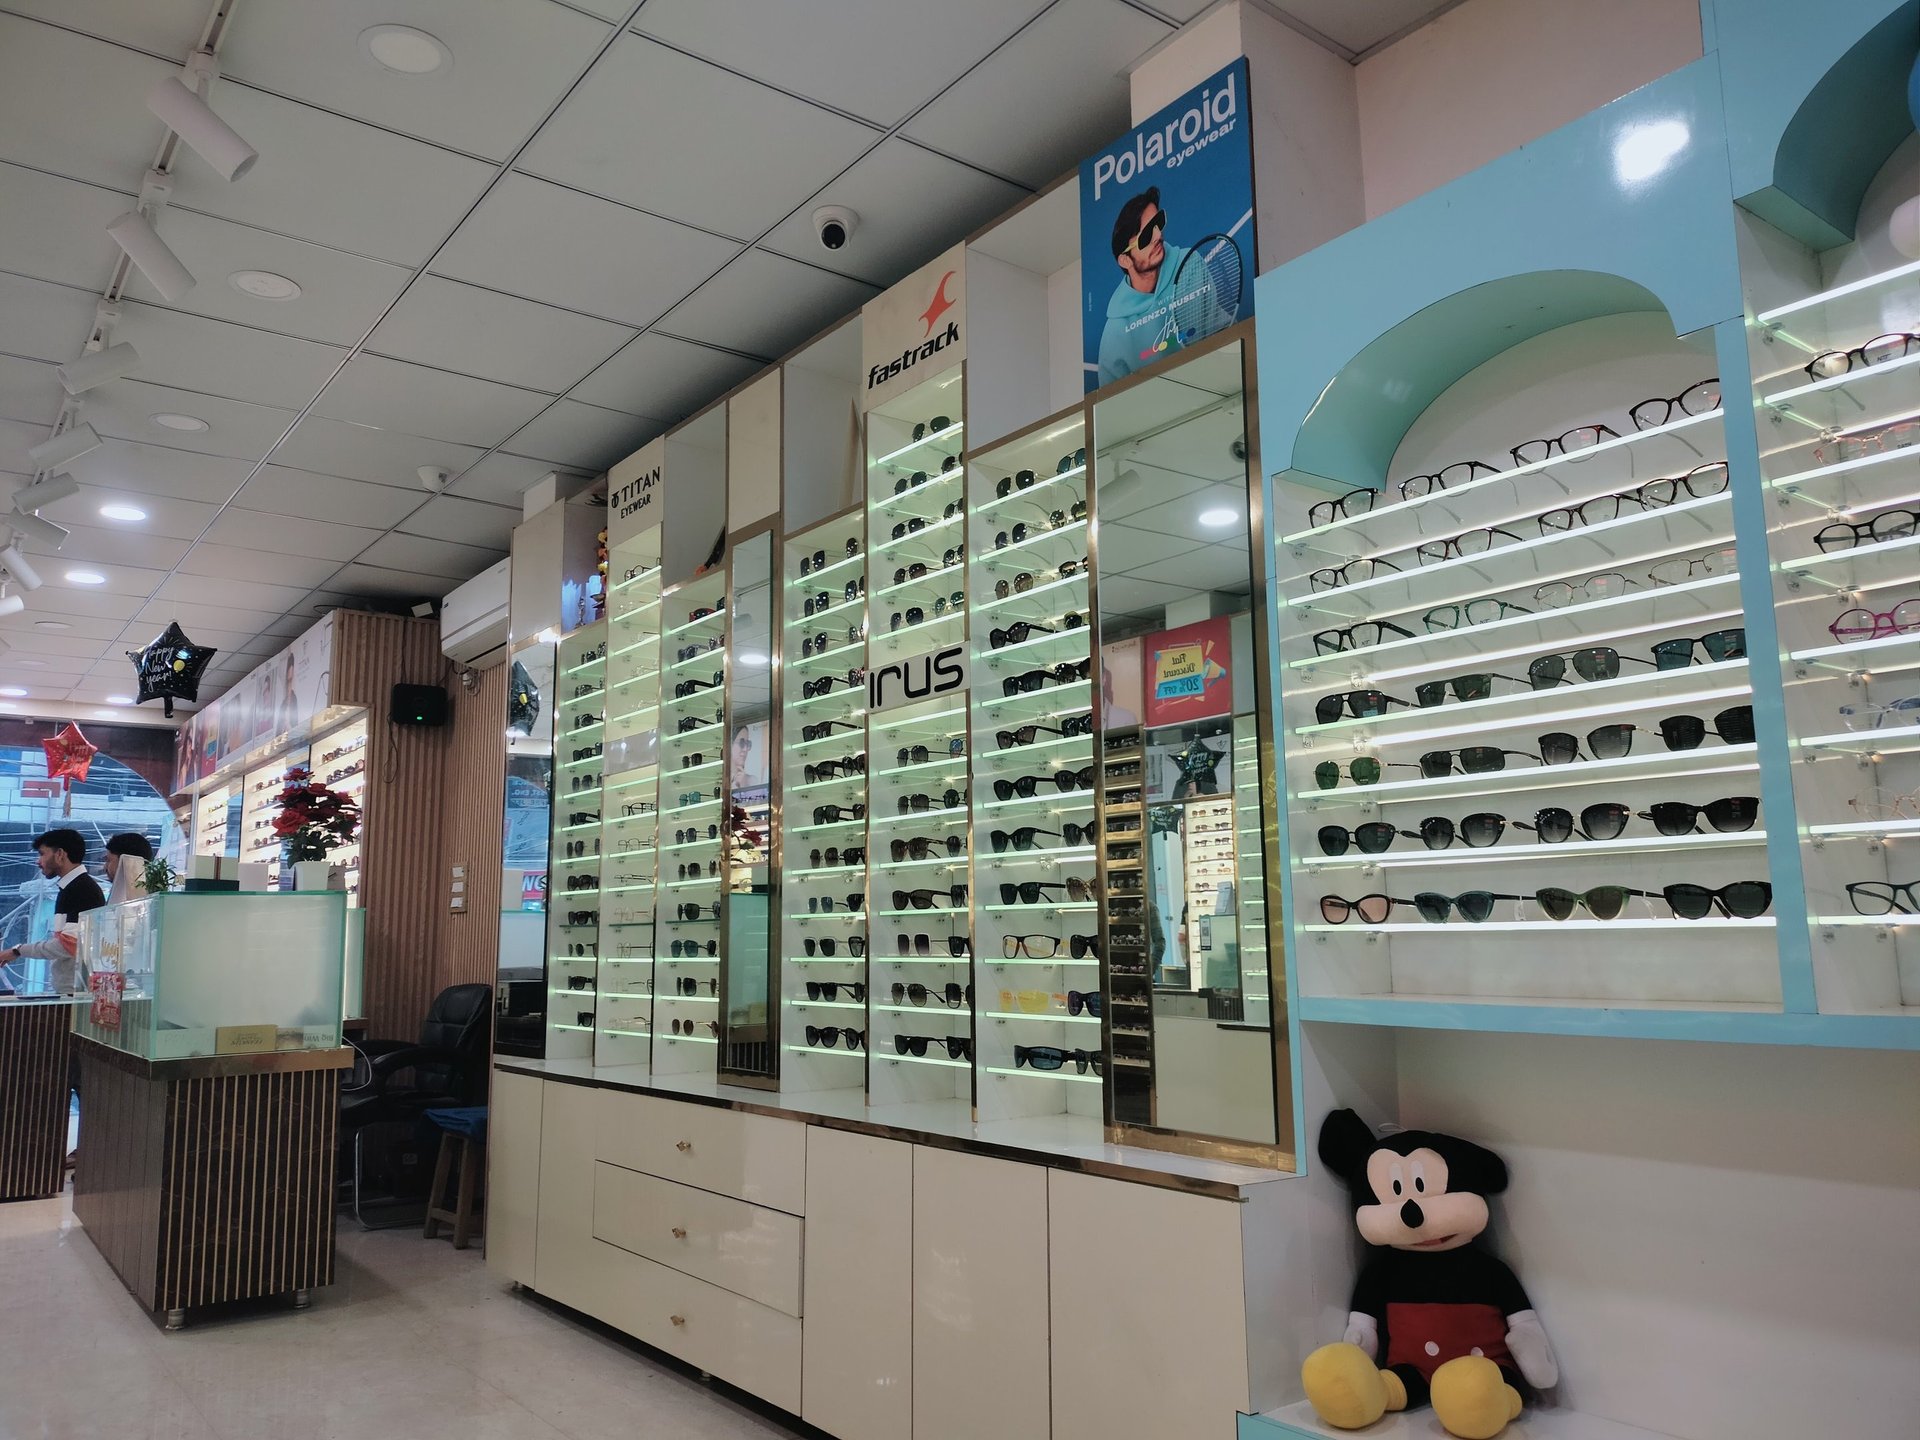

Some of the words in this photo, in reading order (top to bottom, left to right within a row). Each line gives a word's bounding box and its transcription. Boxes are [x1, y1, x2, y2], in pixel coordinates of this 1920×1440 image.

[1094, 72, 1236, 201] Polaroid
[1166, 118, 1236, 168] eyewear
[1125, 306, 1167, 333] LORENZO
[1168, 283, 1212, 312] MUSETTI
[868, 321, 960, 390] fastrack
[620, 493, 651, 519] EYEWEAR
[621, 466, 660, 503] TITAN
[145, 661, 167, 675] New
